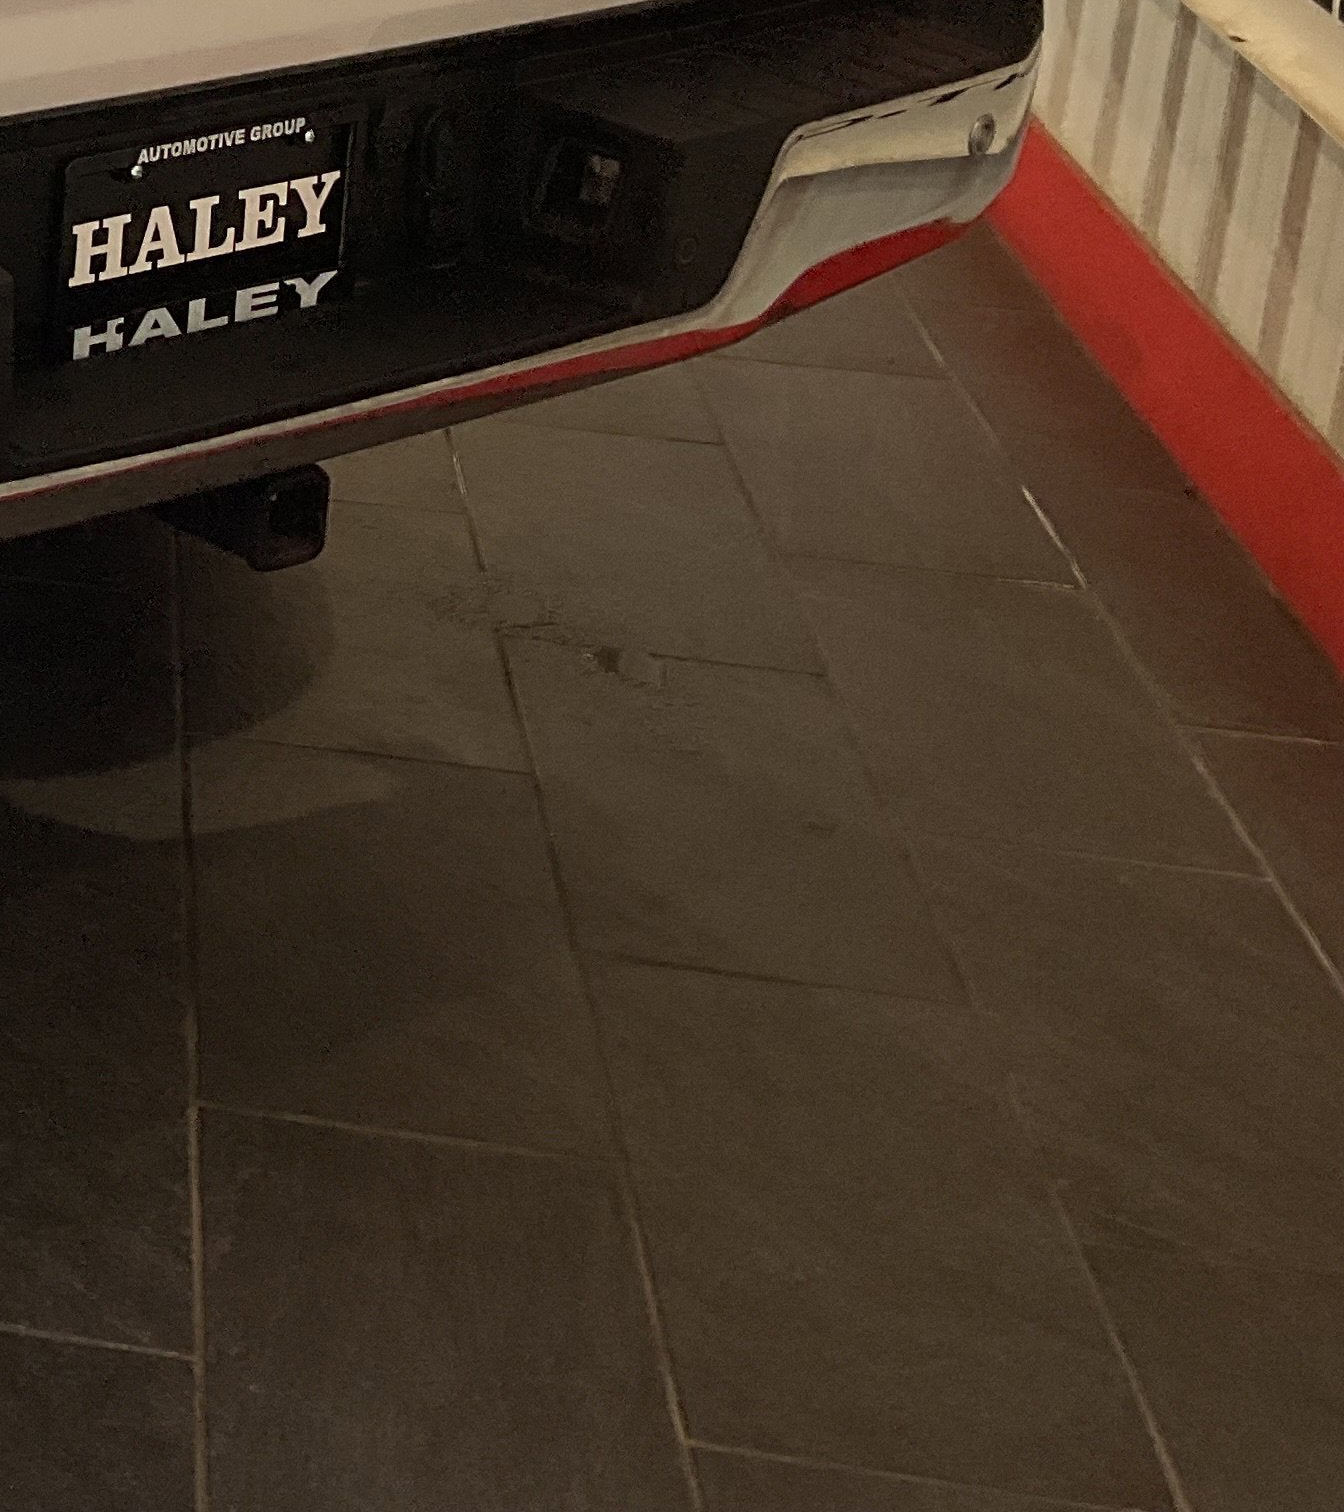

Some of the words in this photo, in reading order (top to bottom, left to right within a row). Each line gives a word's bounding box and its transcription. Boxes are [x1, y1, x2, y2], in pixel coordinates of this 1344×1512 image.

[137, 128, 246, 165] AUTOMOTIVE
[250, 116, 307, 142] GROUP
[68, 169, 341, 288] HALEY
[72, 269, 339, 361] HALEY
